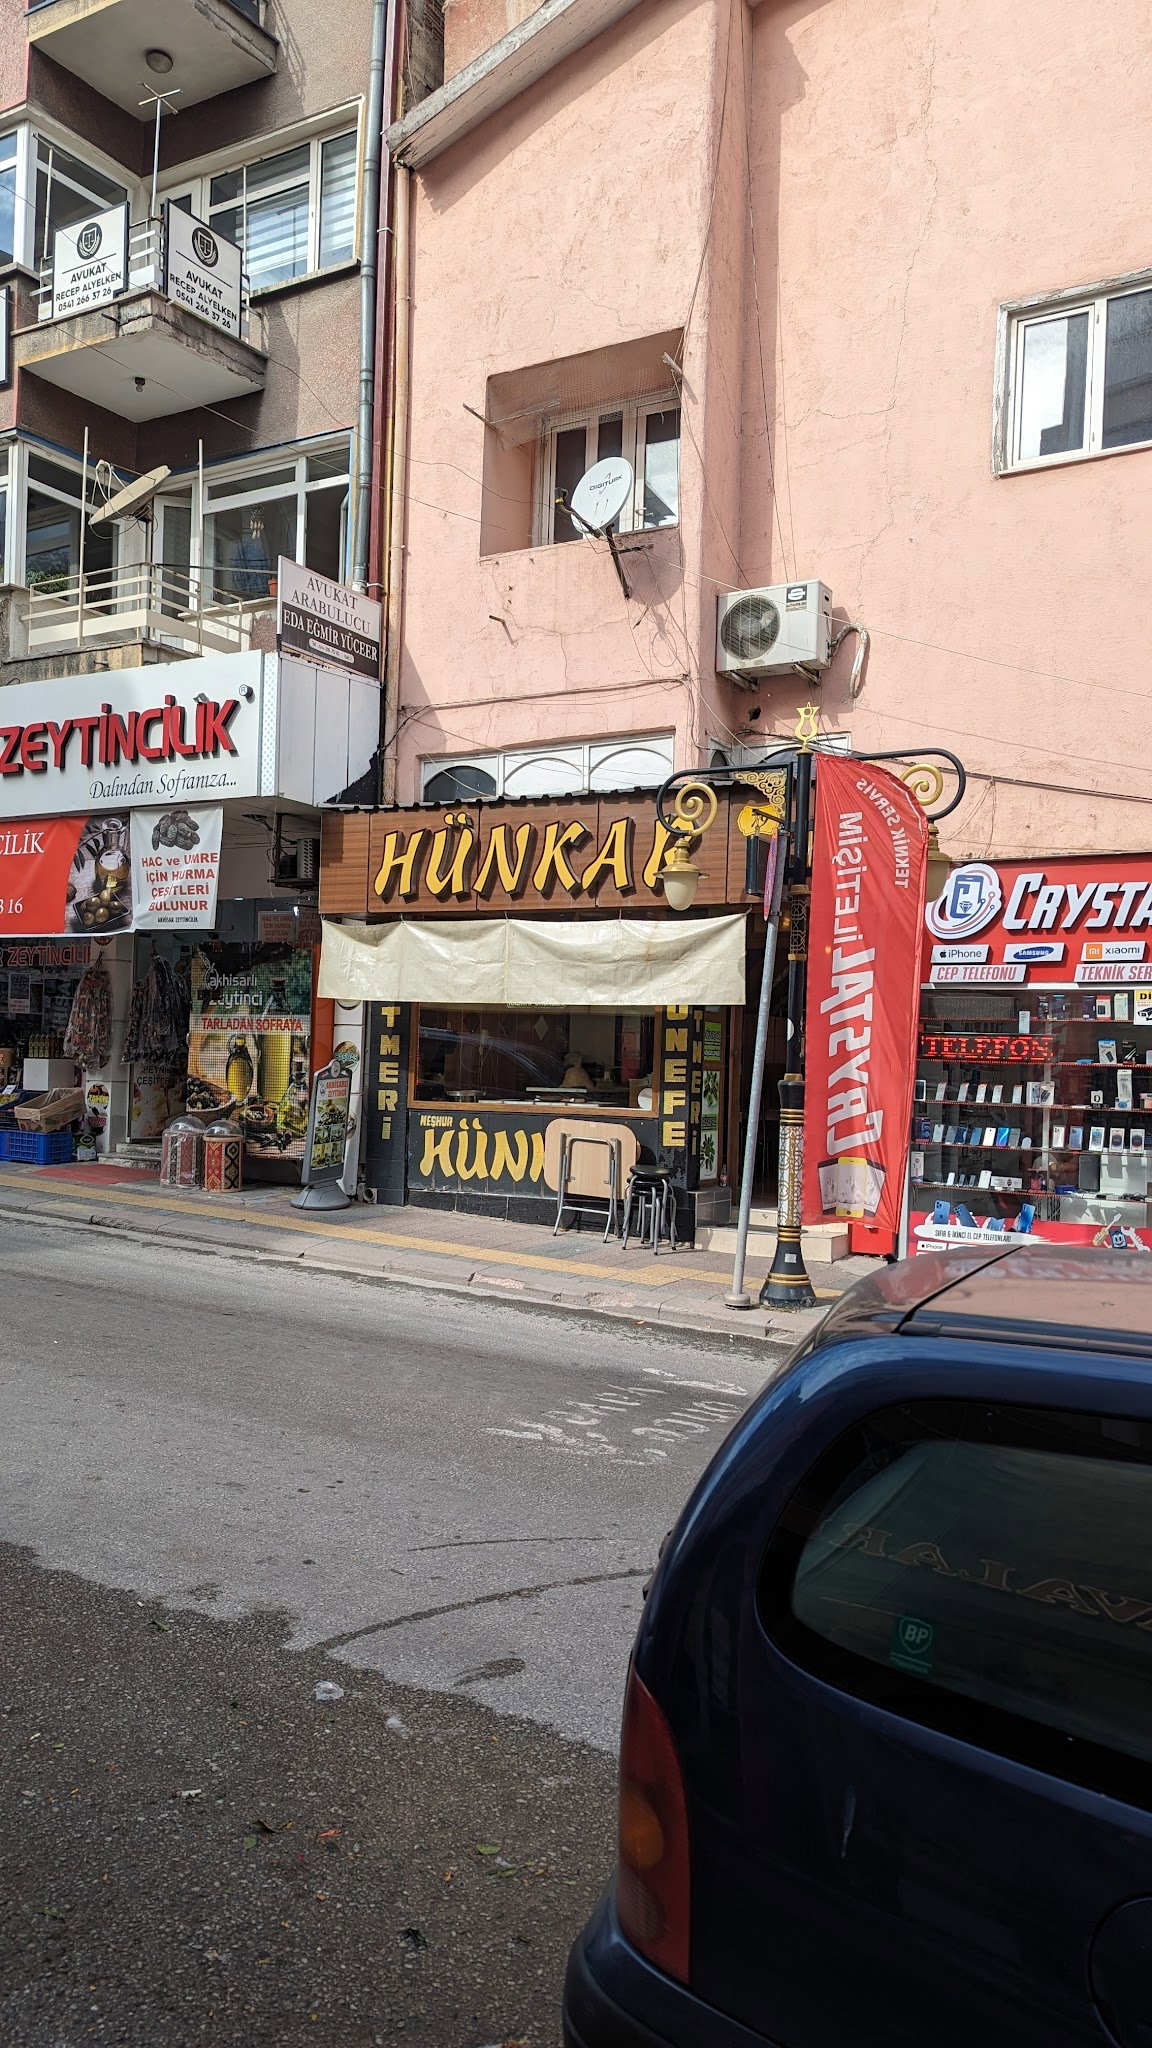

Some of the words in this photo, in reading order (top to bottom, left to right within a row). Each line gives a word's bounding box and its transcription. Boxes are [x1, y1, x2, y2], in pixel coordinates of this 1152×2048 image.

[70, 262, 107, 284] AVUKAT
[55, 287, 80, 301] RECEP
[82, 271, 122, 292] ALYELKEN
[186, 270, 223, 300] AVUKAT
[58, 300, 75, 312] 0541
[77, 294, 90, 306] 266
[92, 291, 101, 301] 37
[102, 288, 112, 297] 26
[170, 273, 196, 295] RECEP
[198, 292, 237, 322] ALYELKEN
[176, 289, 194, 307] 0541
[195, 302, 210, 317] 266
[212, 311, 221, 323] 37
[222, 317, 231, 329] 26
[306, 577, 358, 610] AVUKAT
[291, 589, 371, 635] ARABULUCU
[283, 609, 305, 632] EDA
[306, 618, 339, 646] EĞMİR
[340, 632, 378, 662] YÜCEER
[89, 776, 154, 799] Dalından
[141, 856, 163, 868] HAC
[165, 857, 181, 866] ve
[183, 852, 219, 864] UMRE
[146, 870, 168, 885] İÇİN
[172, 868, 215, 882] HURMA
[151, 882, 210, 900] ÇEŞİTLERİ
[1002, 872, 1152, 931] CRYSTA
[7, 897, 23, 914] 16
[148, 900, 209, 912] BULUNUR
[948, 949, 982, 959] iPhone
[1105, 946, 1140, 955] xiaomi
[937, 966, 959, 981] CEP
[962, 966, 1017, 981] TELEFONU
[1081, 964, 1125, 981] TEKNİK
[201, 1017, 254, 1031] TARLADAN
[255, 1018, 303, 1032] SOFRAYA
[904, 1623, 929, 1645] BP
